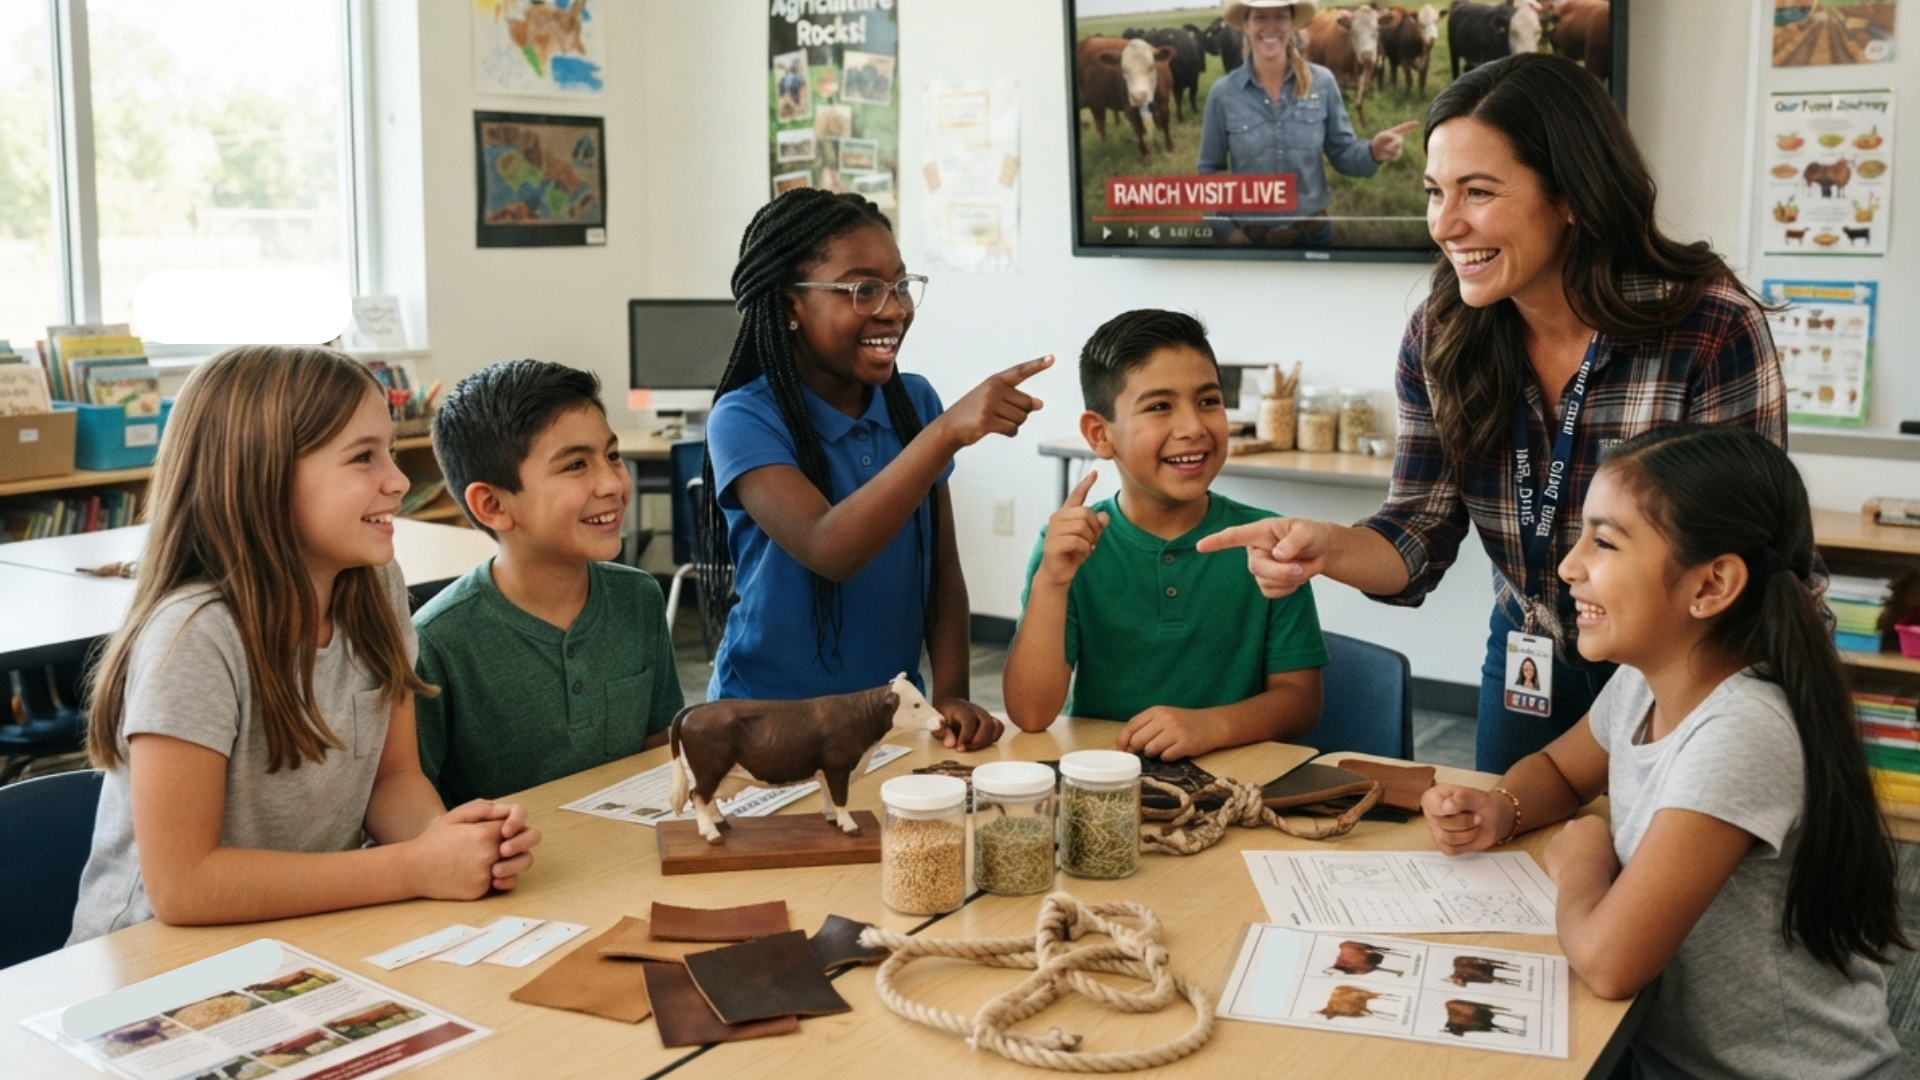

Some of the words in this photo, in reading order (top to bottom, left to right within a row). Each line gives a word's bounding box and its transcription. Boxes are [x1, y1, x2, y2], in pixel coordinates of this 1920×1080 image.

[796, 14, 867, 46] Rocks!
[1113, 182, 1181, 205] RANCH
[1184, 181, 1238, 205] VISIT
[1241, 181, 1287, 204] LIVE
